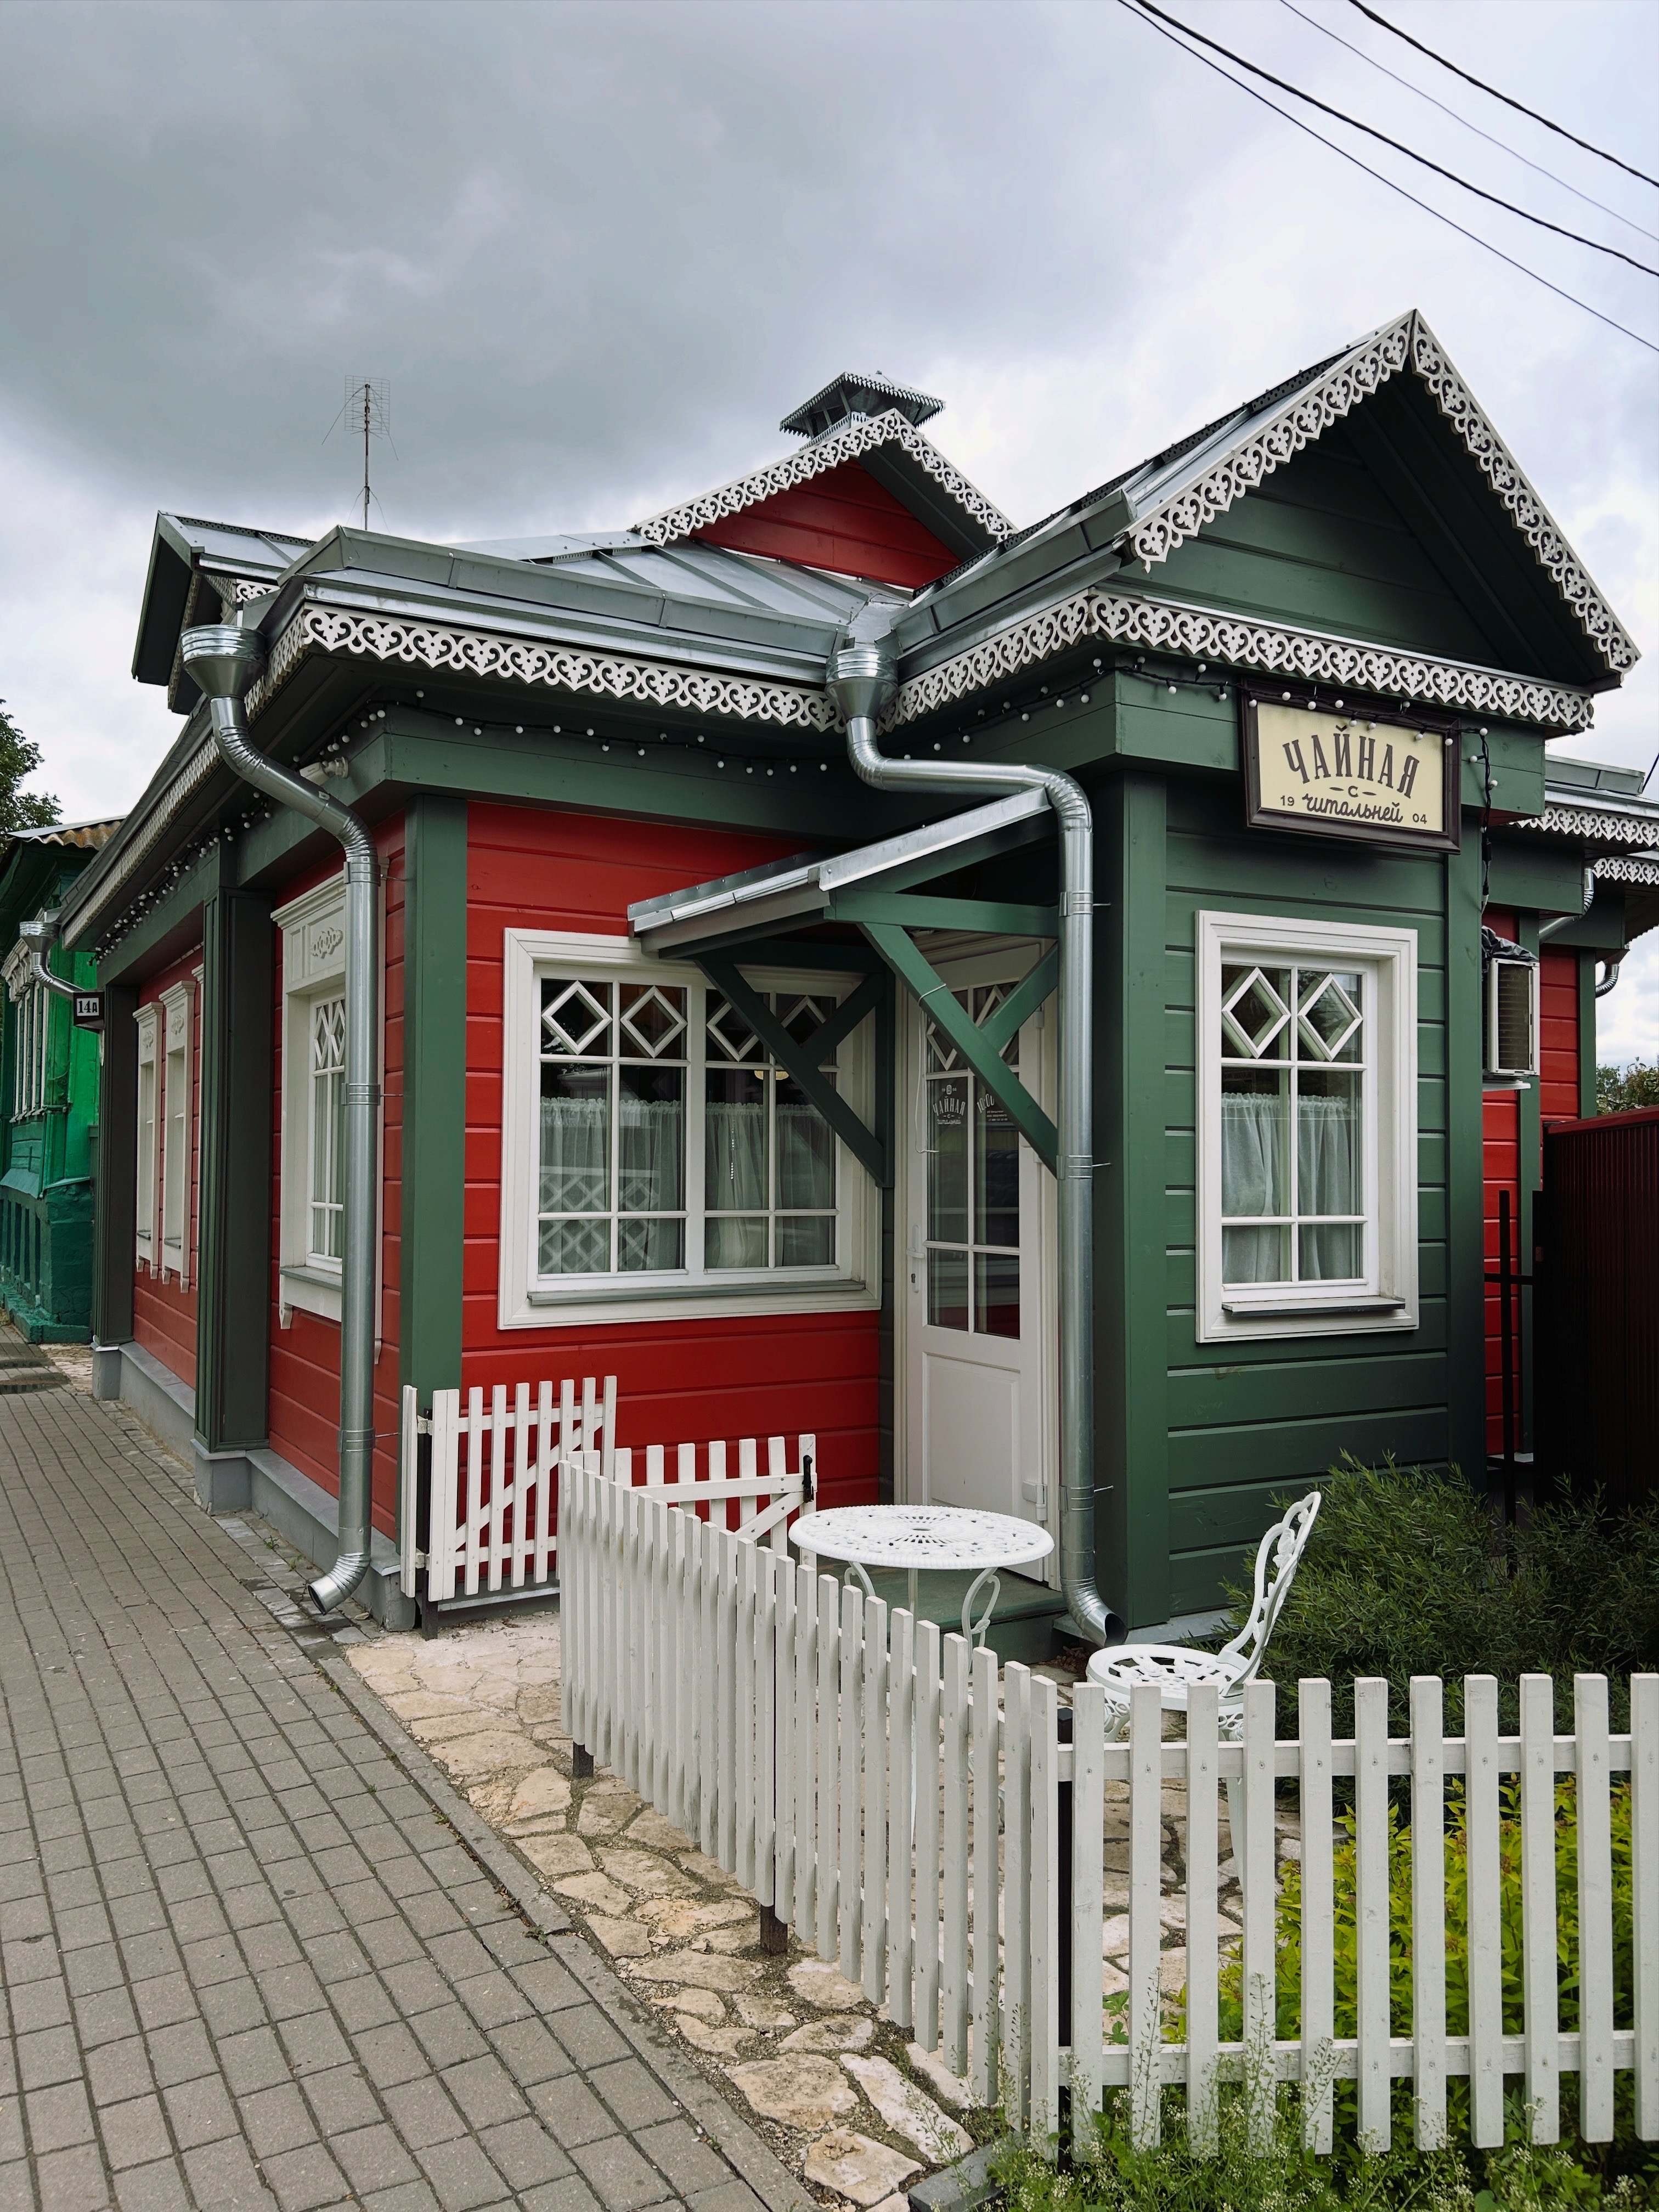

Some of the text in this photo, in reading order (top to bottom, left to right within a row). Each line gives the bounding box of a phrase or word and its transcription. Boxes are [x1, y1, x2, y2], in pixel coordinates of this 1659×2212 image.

[1283, 725, 1420, 799] ЧАЙНАЯ
[1280, 793, 1427, 824] 19 читальней 04
[933, 1096, 966, 1116] ЧАЙНАЯ
